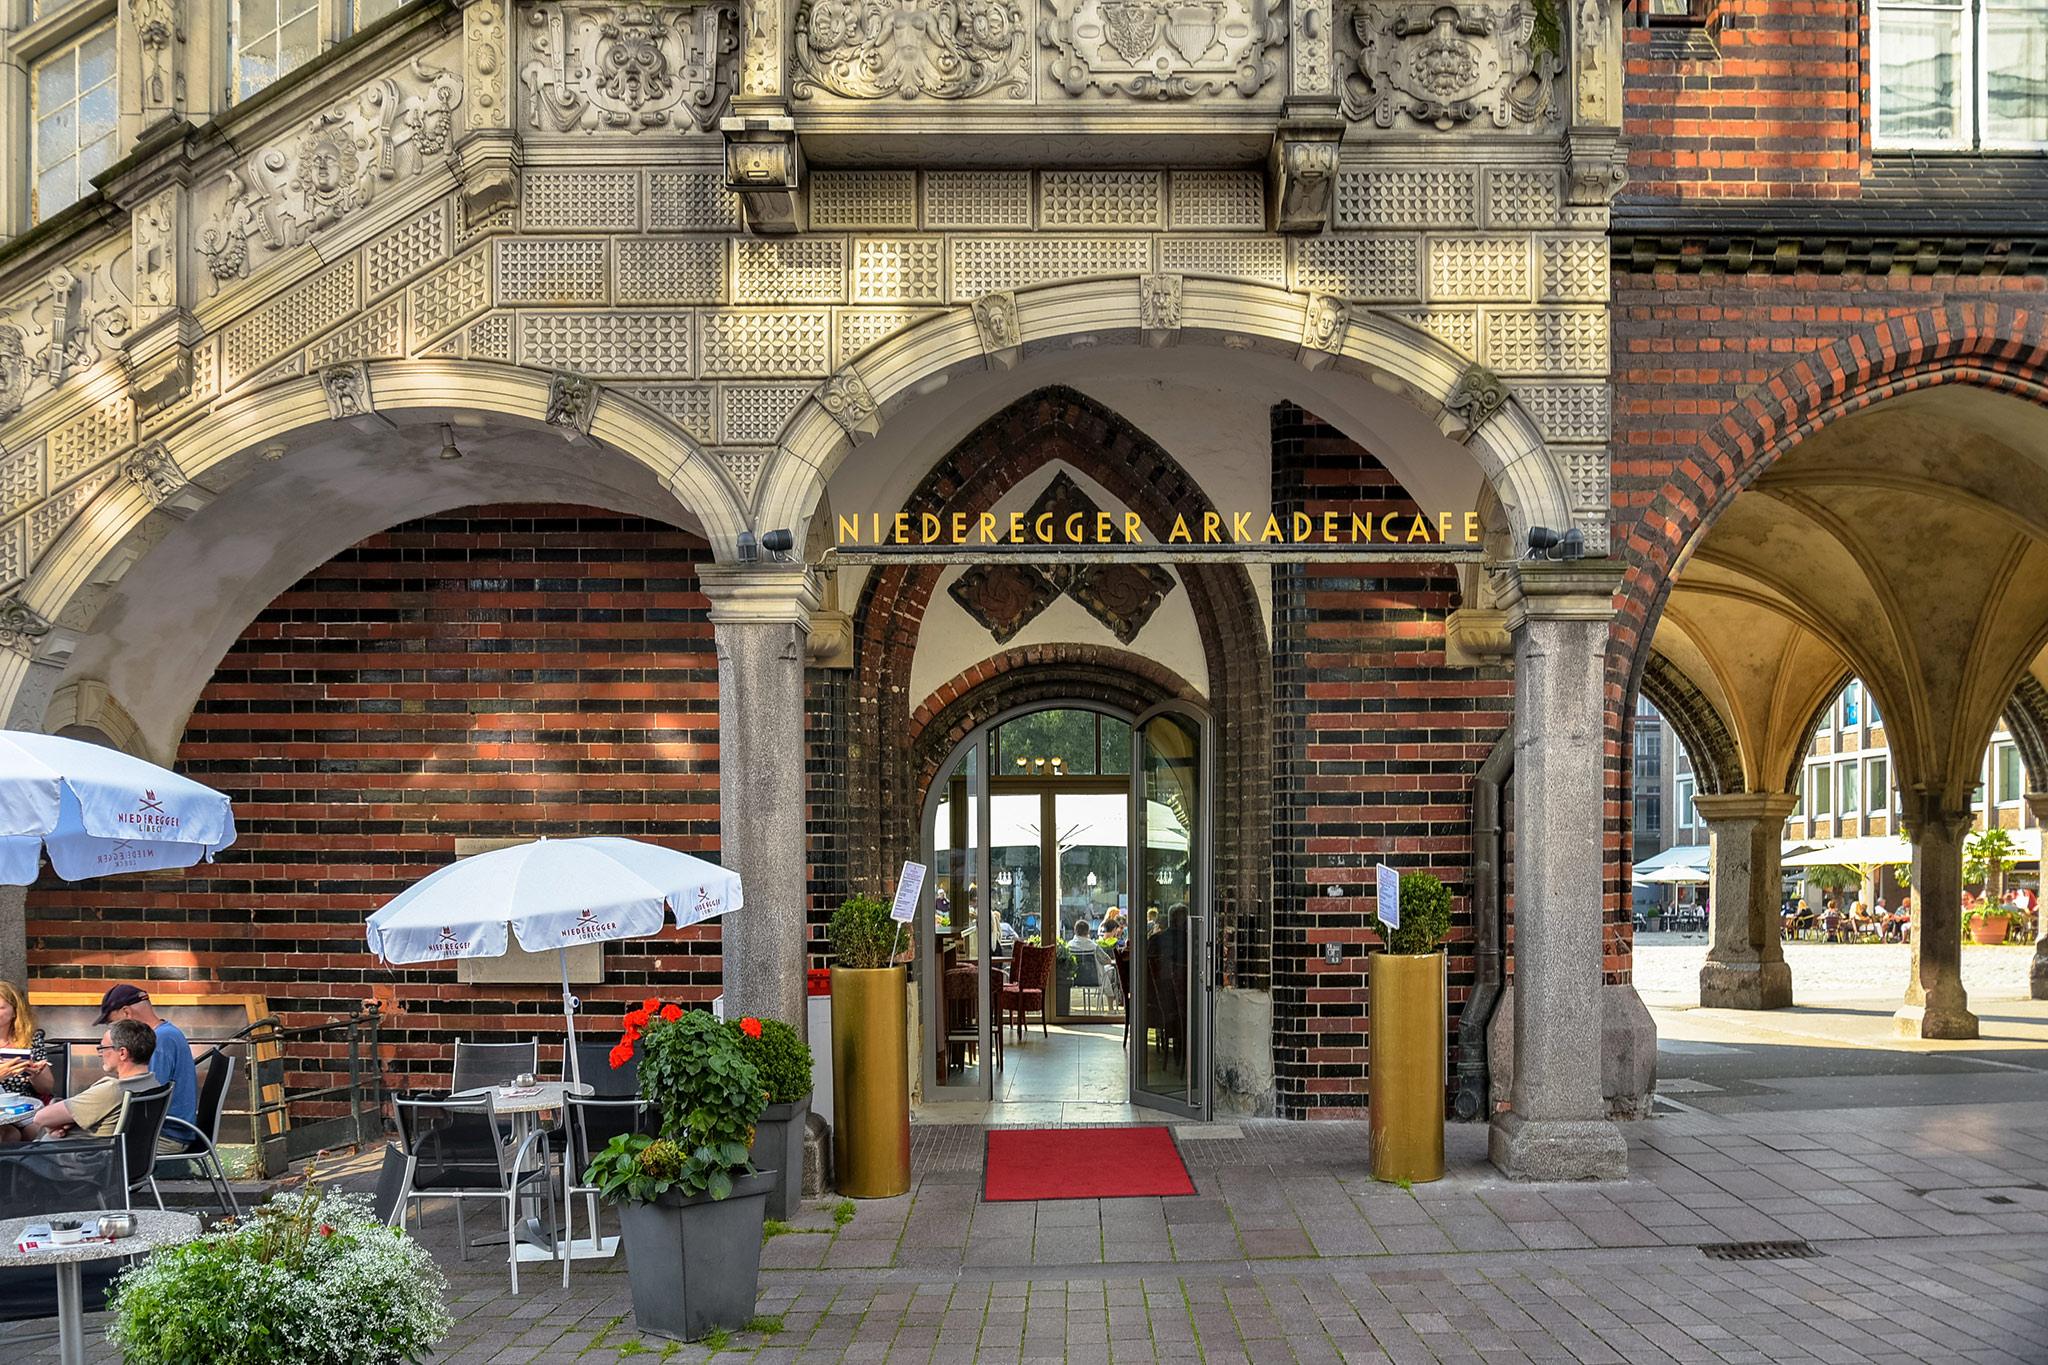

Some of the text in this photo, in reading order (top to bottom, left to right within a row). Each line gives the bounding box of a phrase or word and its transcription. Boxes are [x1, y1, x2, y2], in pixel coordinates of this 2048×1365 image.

[839, 511, 1479, 543] NIEDEREGGER ARKADENCAFE
[561, 922, 617, 937] NIEDEREGGER
